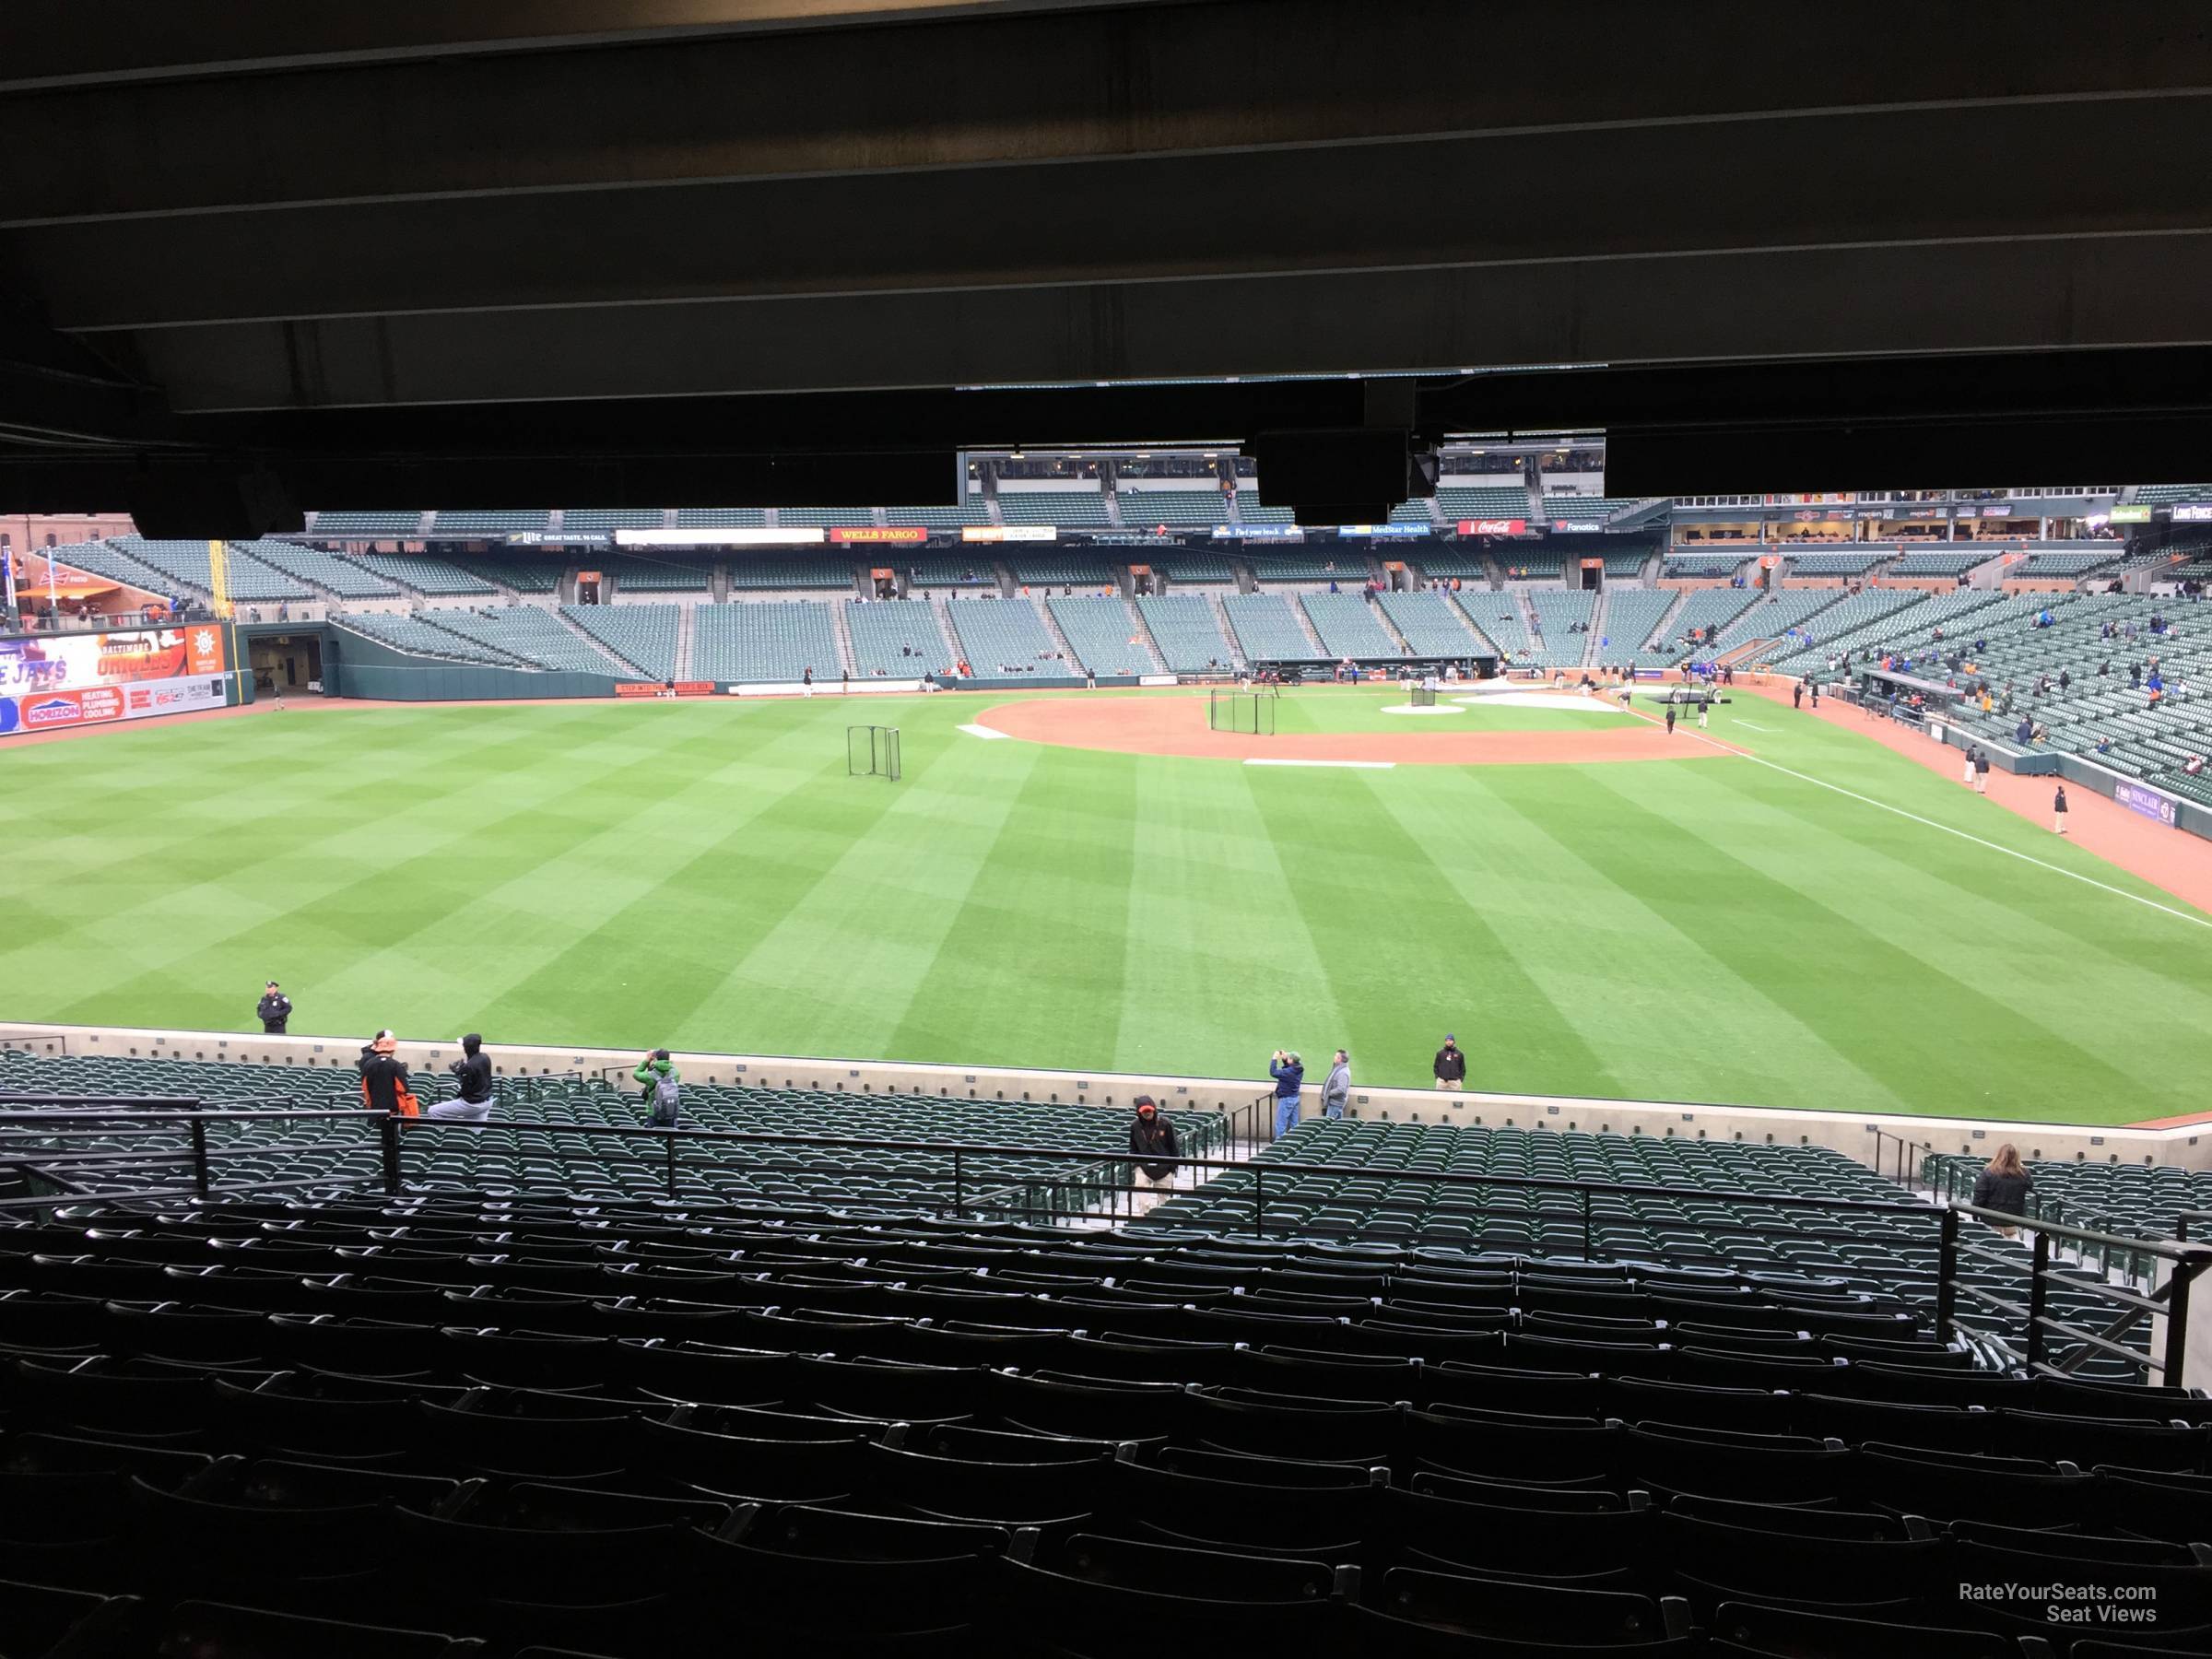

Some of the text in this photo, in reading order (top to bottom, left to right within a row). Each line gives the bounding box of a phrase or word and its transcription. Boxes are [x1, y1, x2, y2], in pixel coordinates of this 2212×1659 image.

[841, 530, 918, 539] WELLS FARGO
[102, 643, 148, 655] BALTIMORE
[82, 690, 113, 701] HEATING
[82, 698, 119, 710] PLUMBING
[29, 706, 79, 721] HORIZON
[83, 707, 116, 718] COOLING
[2132, 789, 2158, 810] SINCLAIR
